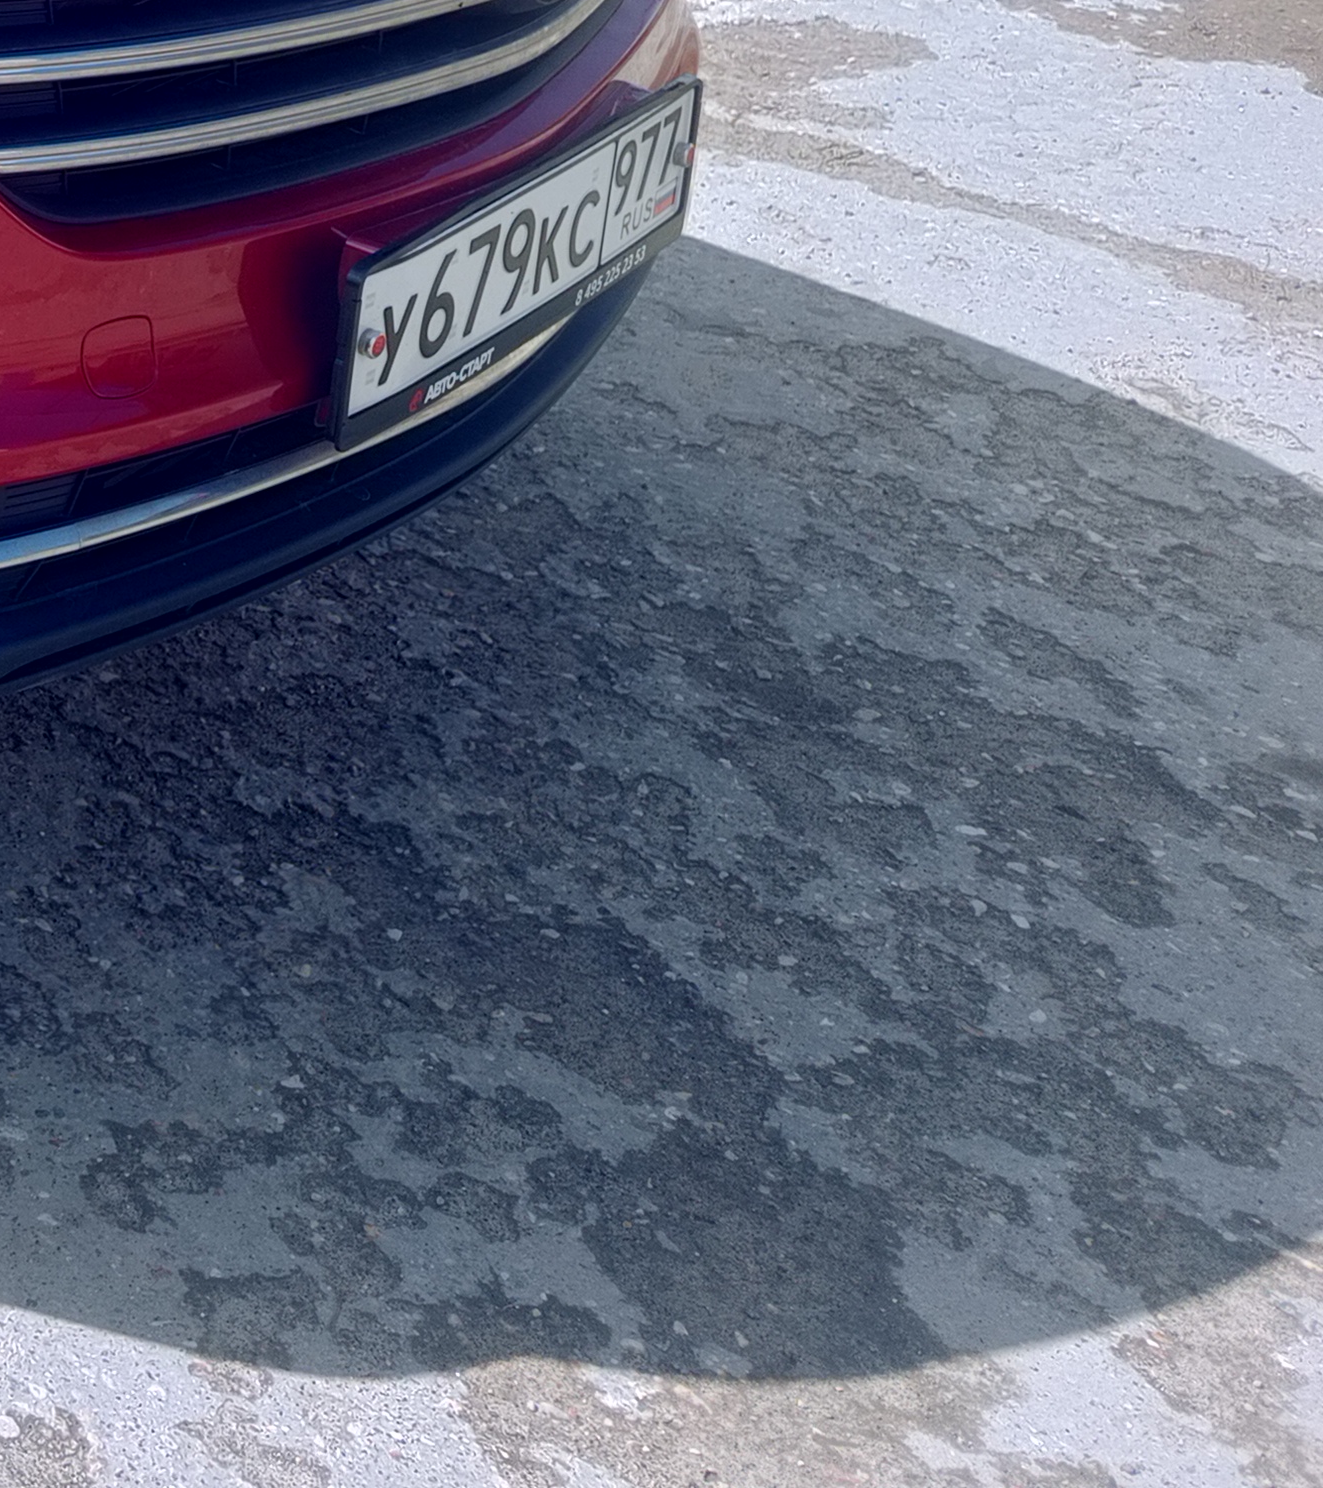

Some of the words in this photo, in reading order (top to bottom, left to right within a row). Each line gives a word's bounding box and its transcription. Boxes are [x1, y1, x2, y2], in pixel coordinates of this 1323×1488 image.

[377, 189, 601, 387] У679КС
[613, 105, 683, 218] 977
[620, 197, 654, 240] RUS
[575, 289, 583, 307] 8
[584, 276, 603, 298] 495
[603, 262, 621, 287] 225
[621, 253, 634, 274] 23
[634, 244, 647, 265] 53
[423, 346, 496, 405] АВТО-СТАРТ
